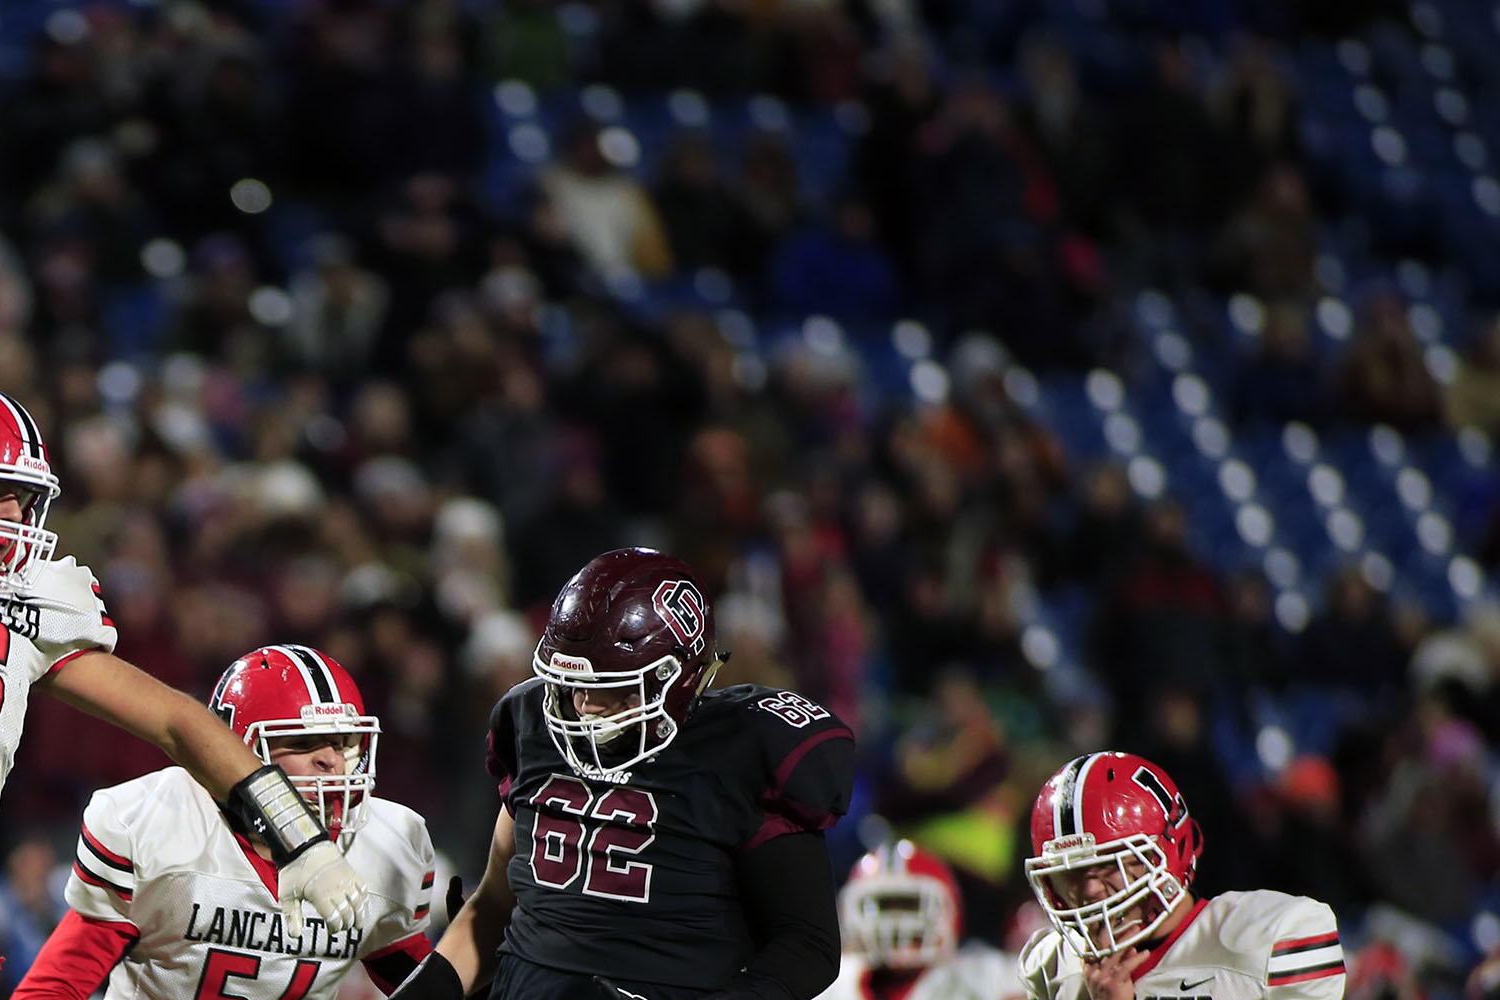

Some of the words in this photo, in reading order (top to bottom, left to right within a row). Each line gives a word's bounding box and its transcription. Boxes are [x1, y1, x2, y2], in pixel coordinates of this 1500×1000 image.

[315, 706, 344, 715] Riddell
[757, 691, 831, 728] 62
[529, 772, 659, 903] 62
